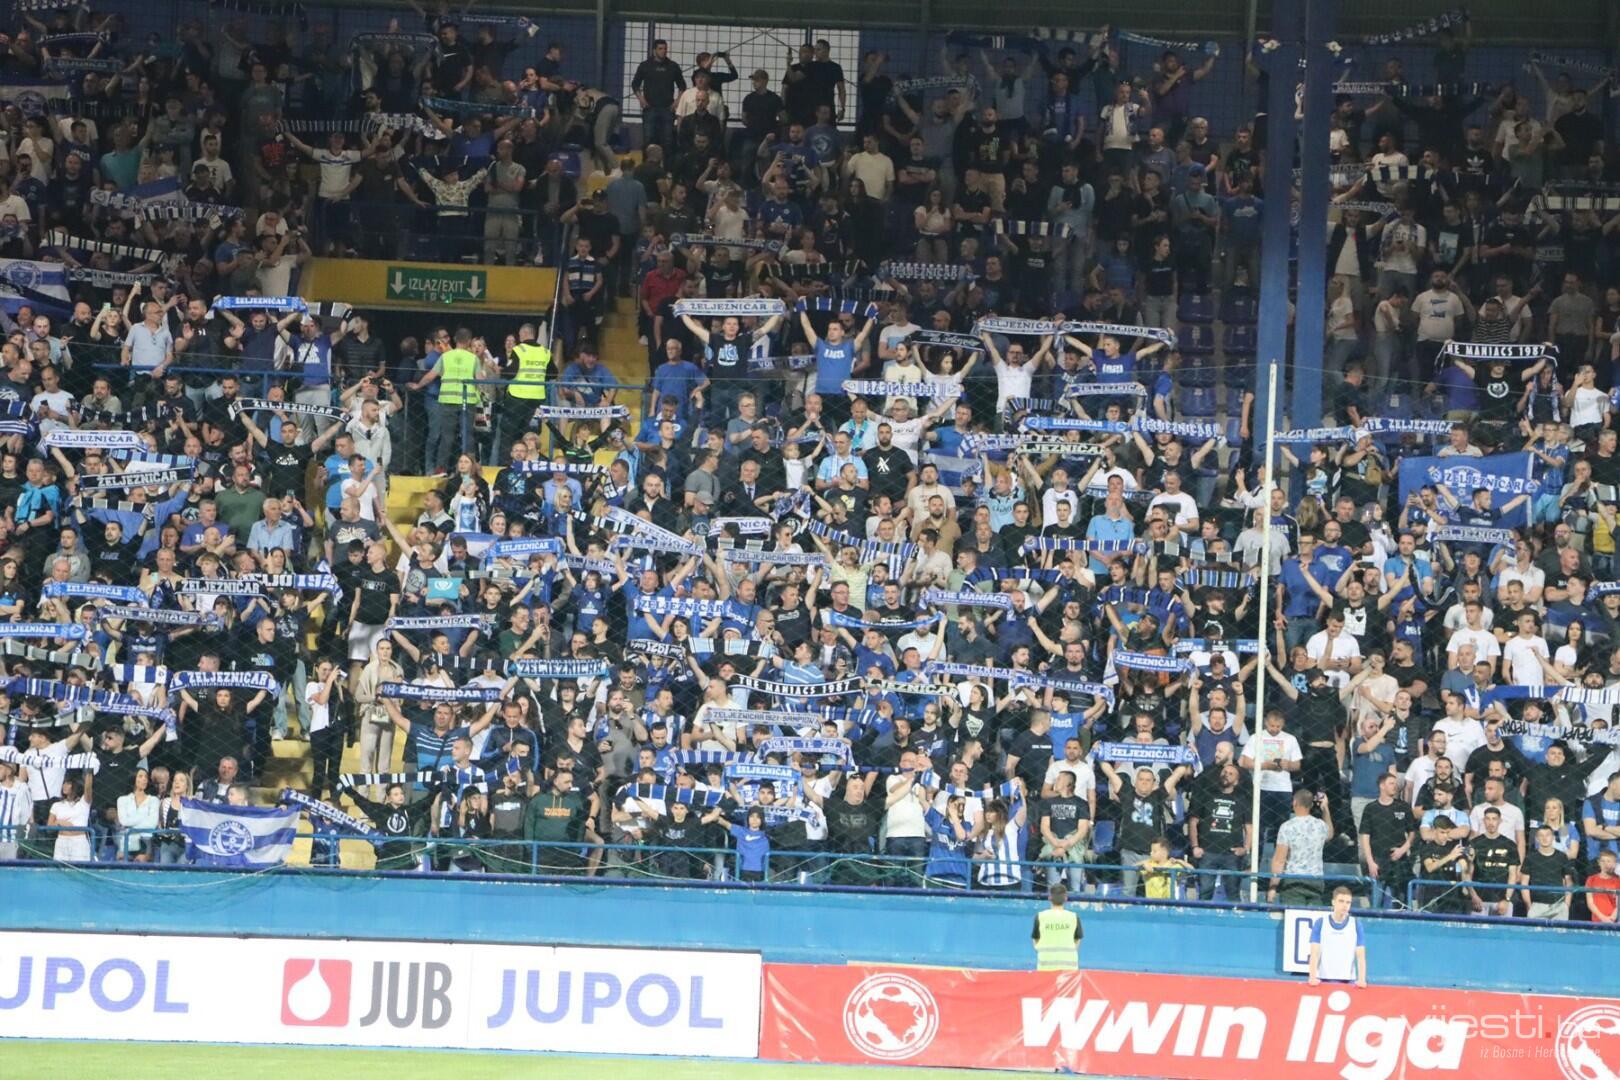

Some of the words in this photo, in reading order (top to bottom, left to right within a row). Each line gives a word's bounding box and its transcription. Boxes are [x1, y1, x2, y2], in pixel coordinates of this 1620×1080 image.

[409, 278, 465, 294] IZLAZ/EXIT
[1447, 344, 1460, 355] HE
[1465, 344, 1513, 357] MANIACS
[1519, 345, 1545, 356] 1987
[739, 675, 760, 688] THE
[767, 682, 816, 695] MANIACS
[822, 680, 850, 693] 1987
[0, 956, 190, 1014] UPOL
[361, 961, 453, 1030] JUB
[487, 969, 724, 1030] JUPOL
[1287, 989, 1470, 1080] liga
